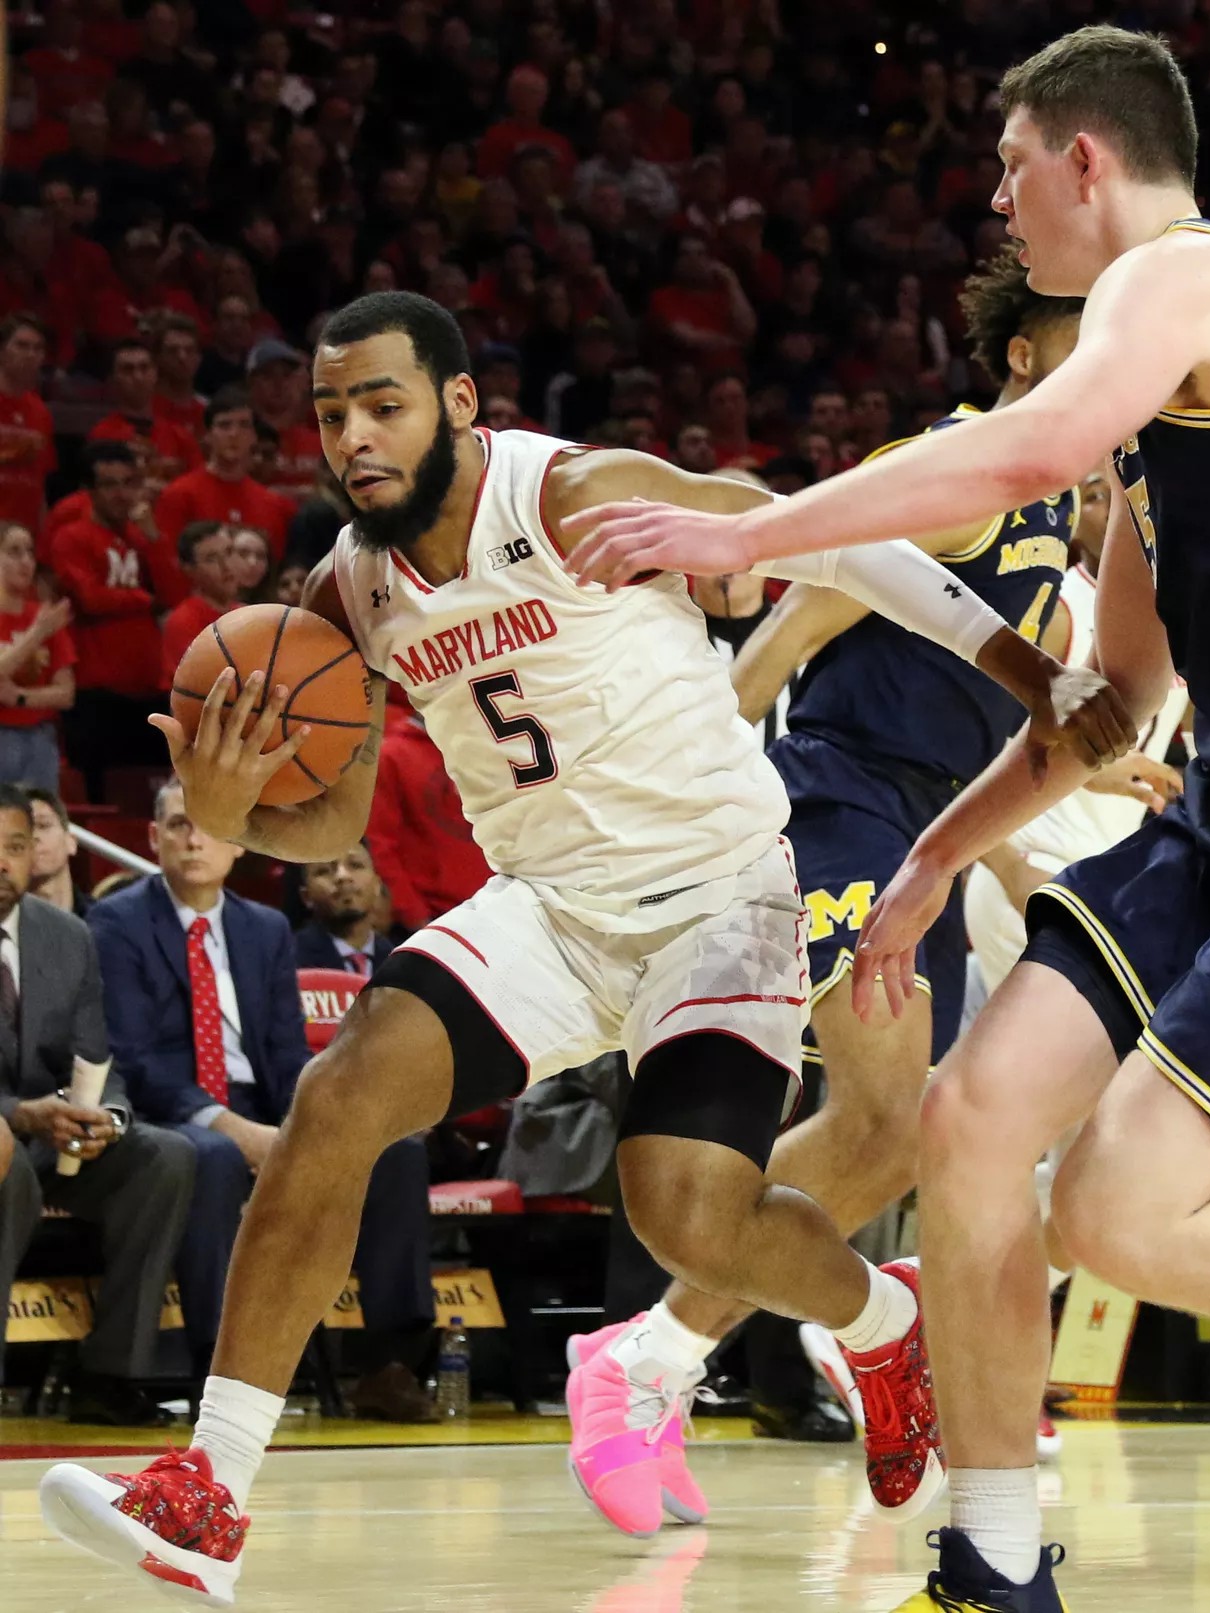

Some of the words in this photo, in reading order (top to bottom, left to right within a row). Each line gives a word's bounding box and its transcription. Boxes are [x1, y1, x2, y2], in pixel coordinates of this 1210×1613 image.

[996, 535, 1069, 576] MICH
[392, 599, 558, 687] MARYLAND
[468, 669, 559, 789] 5
[803, 880, 876, 943] M
